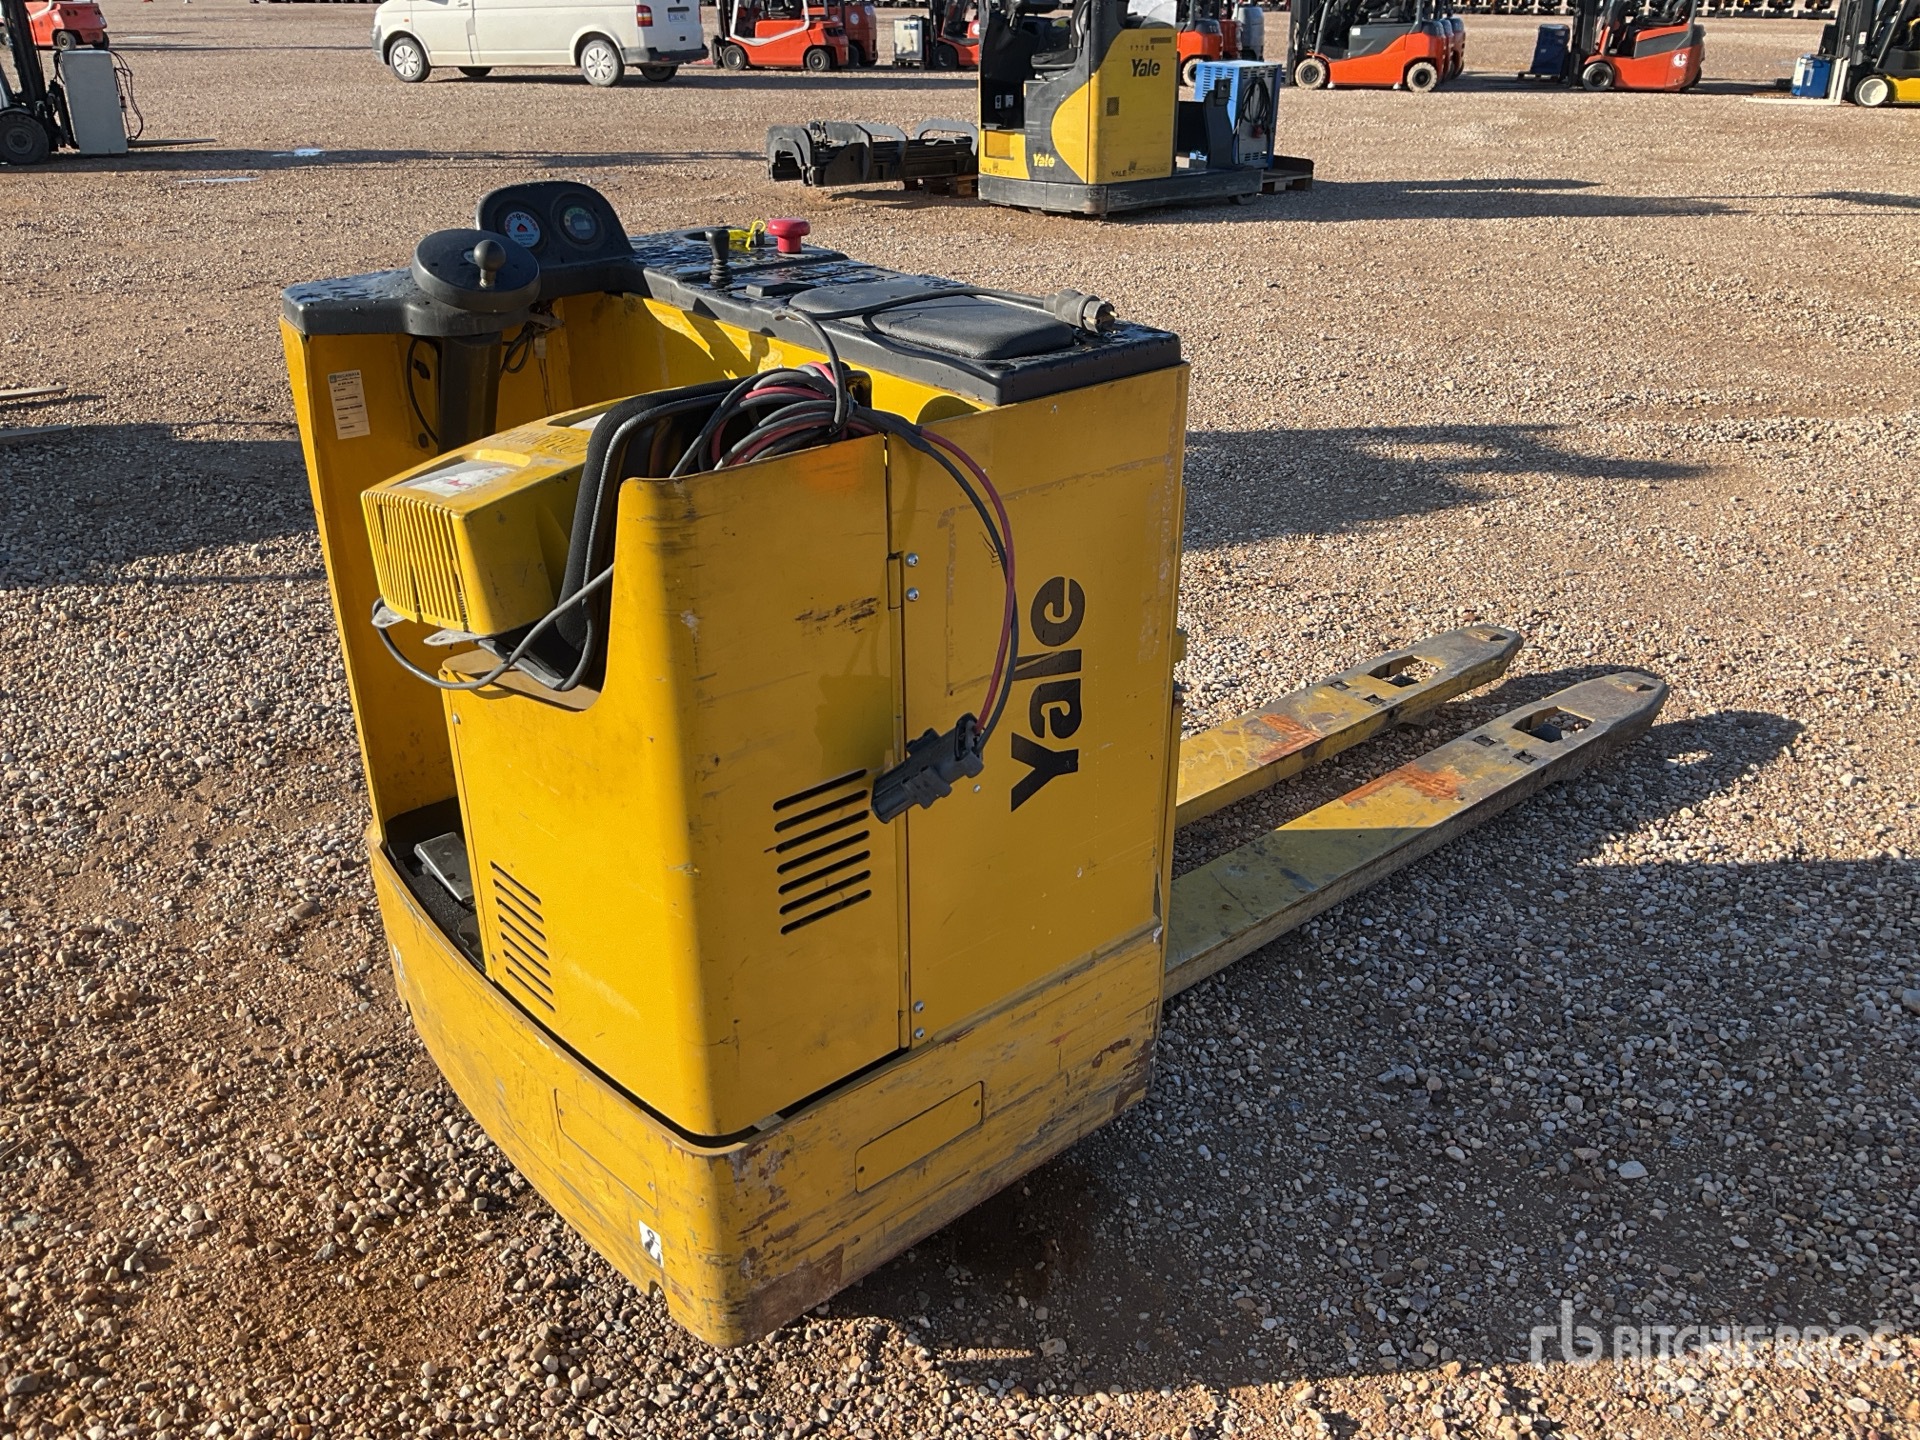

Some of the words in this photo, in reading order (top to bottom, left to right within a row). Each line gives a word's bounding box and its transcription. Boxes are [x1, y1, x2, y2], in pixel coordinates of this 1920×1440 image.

[1131, 58, 1161, 77] Yale
[1033, 153, 1056, 168] Yale
[1011, 576, 1086, 812] Yale
